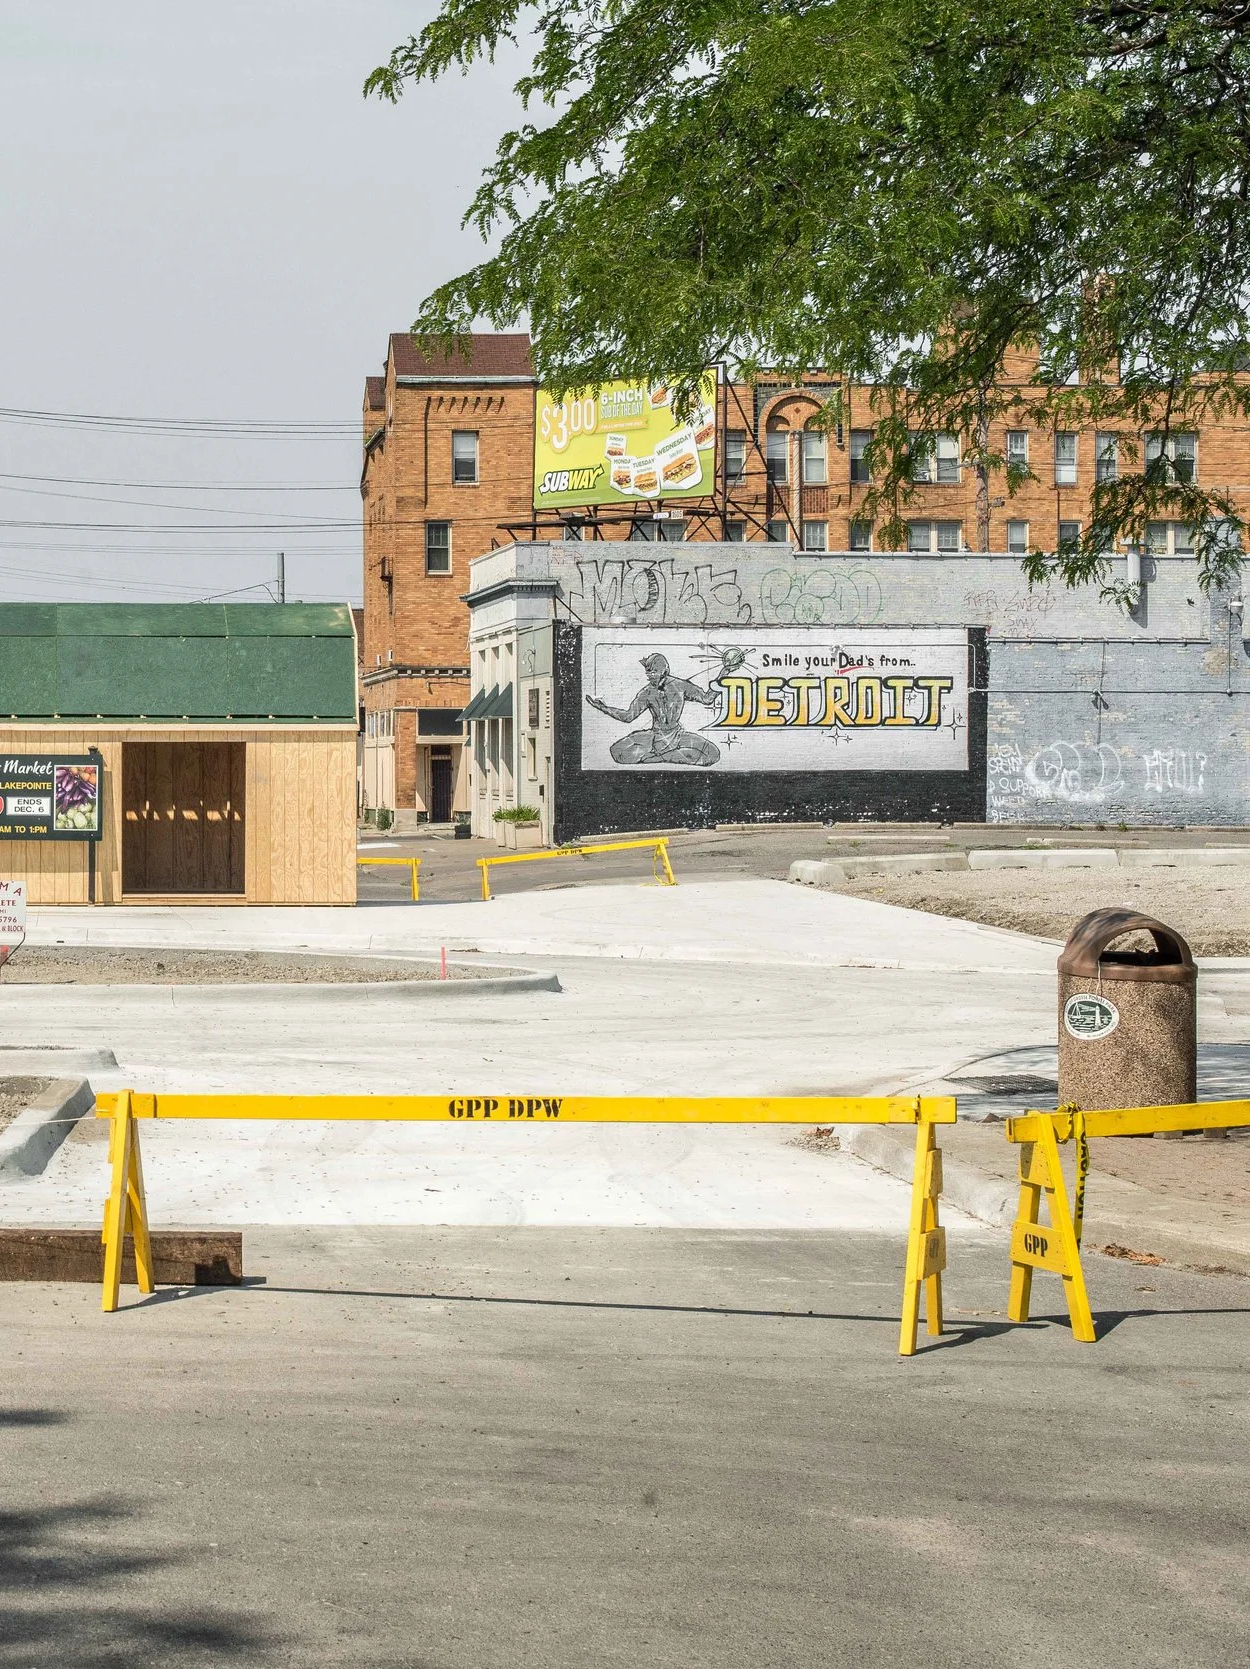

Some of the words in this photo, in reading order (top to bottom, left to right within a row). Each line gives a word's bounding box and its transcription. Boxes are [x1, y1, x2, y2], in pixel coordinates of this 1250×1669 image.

[601, 389, 643, 406] 6-INCH
[656, 432, 692, 456] WEDNESDAY
[632, 457, 655, 469] TUESDAY
[538, 464, 604, 496] SUBWAY
[762, 653, 800, 667] Smile
[805, 656, 836, 671] your
[838, 652, 875, 667] Dad's
[718, 676, 954, 727] DETROIT
[3, 760, 53, 774] Market
[0, 782, 52, 790] LAKEPOINTE
[448, 1099, 499, 1118] GPP
[509, 1098, 564, 1118] DPW
[1024, 1233, 1049, 1258] GPP
